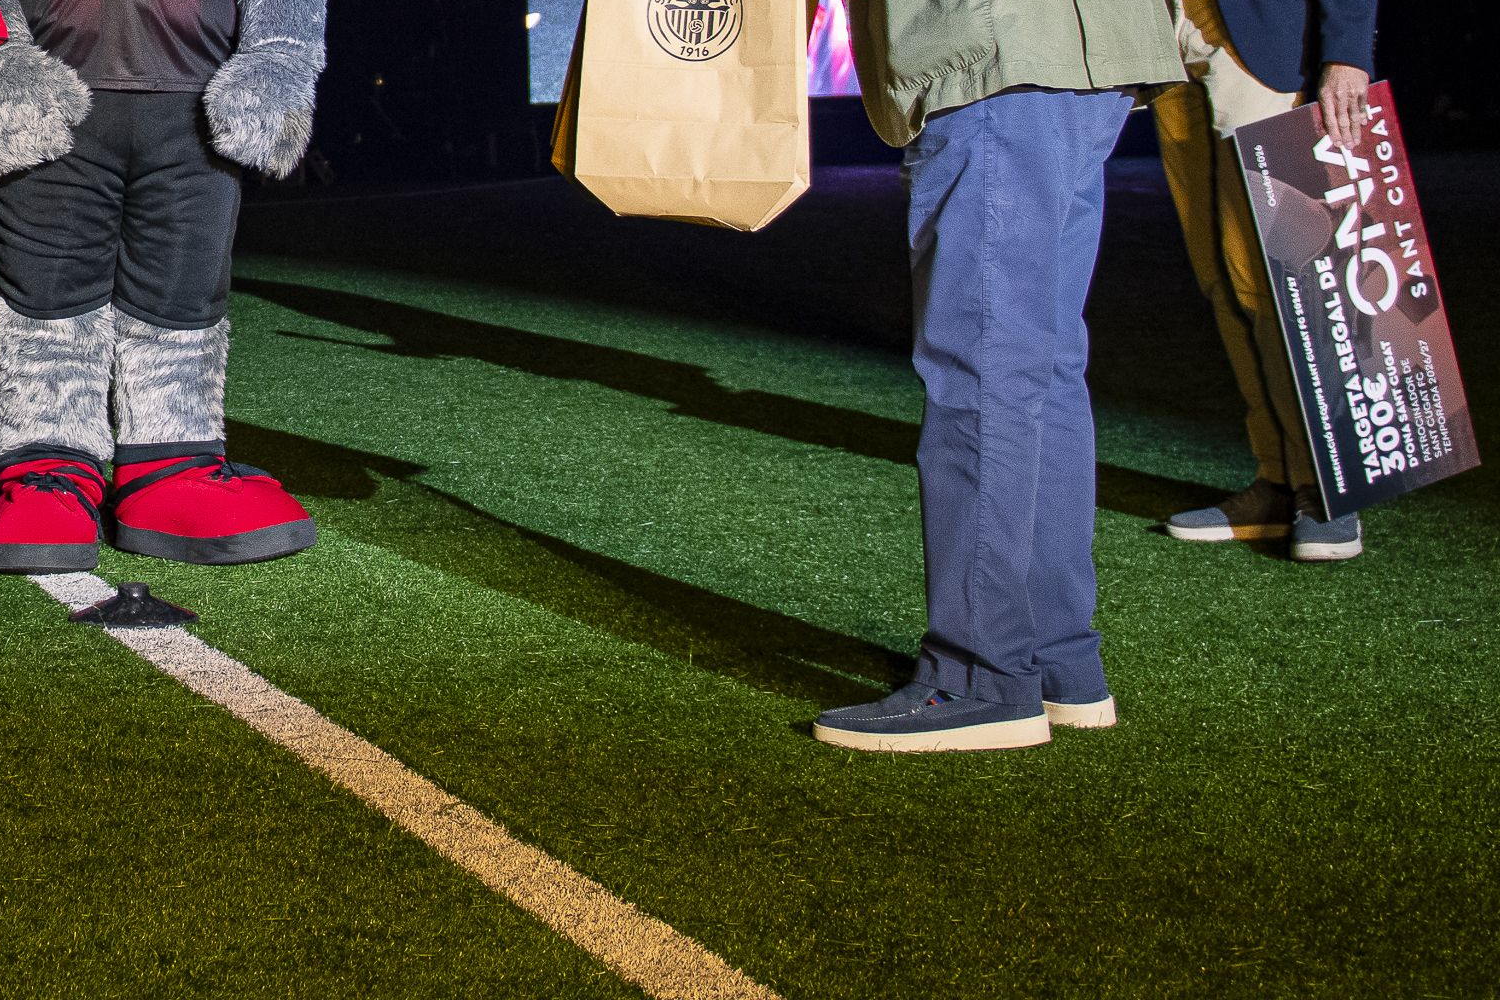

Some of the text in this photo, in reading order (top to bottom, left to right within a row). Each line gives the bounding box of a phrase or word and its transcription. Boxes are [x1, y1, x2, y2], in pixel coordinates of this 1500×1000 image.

[680, 46, 709, 57] 1916
[1253, 144, 1277, 208] Octubre 2026
[1365, 104, 1427, 298] SANT CUGAT
[1312, 135, 1399, 316] ONA
[1286, 276, 1305, 316] 2026/27
[1299, 330, 1315, 363] CUGAT
[1307, 363, 1322, 388] SANT
[1314, 256, 1382, 484] TARGETA REGAL DE
[1362, 372, 1406, 476] 300€
[1379, 340, 1419, 468] D'ONA SANT CUGAT
[1400, 357, 1433, 463] PATROCINADOR DE
[1415, 371, 1443, 459] SANT CUGAT FC
[1416, 339, 1453, 454] TEMPORADA 2026/27
[1323, 431, 1345, 493] PRESENTACIÓ
